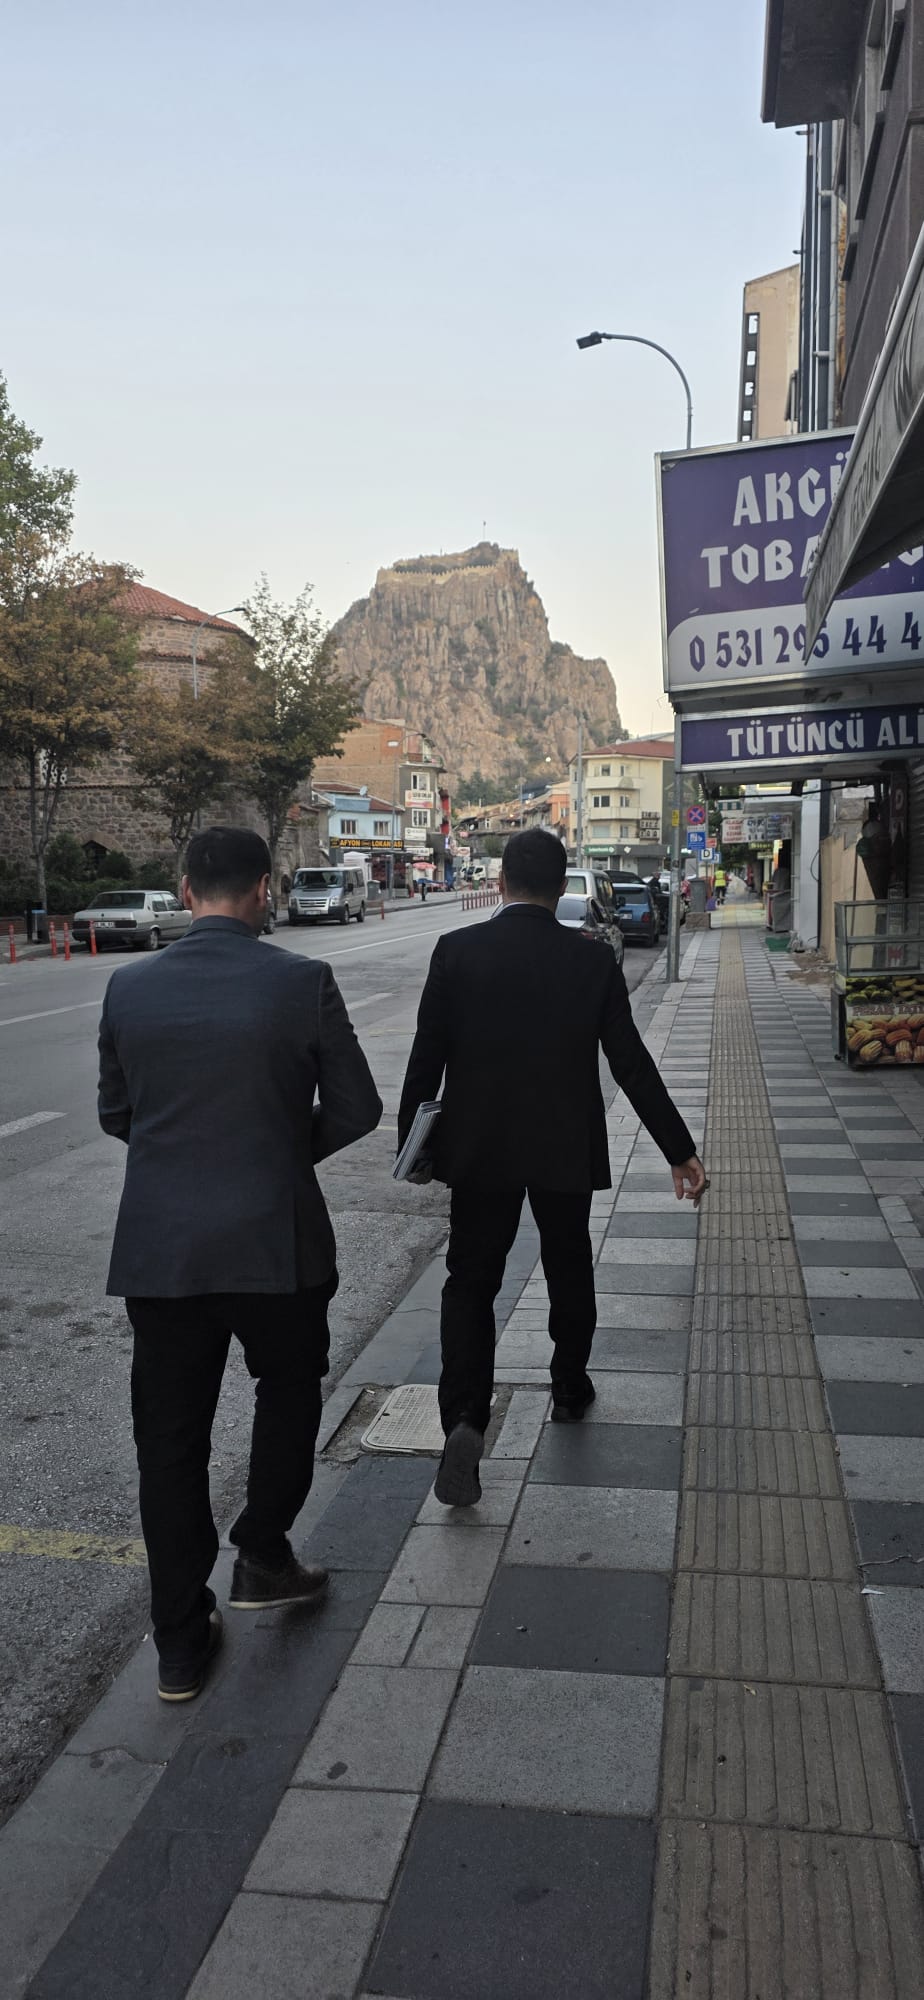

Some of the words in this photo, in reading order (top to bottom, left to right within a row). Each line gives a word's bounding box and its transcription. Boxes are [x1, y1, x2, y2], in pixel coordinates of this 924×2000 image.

[689, 635, 705, 672] 0
[716, 627, 762, 669] 531
[842, 615, 887, 656] 44
[727, 712, 864, 757] TÜTÜNCÜ
[340, 839, 360, 848] AFYON
[371, 839, 403, 849] LOKANASI
